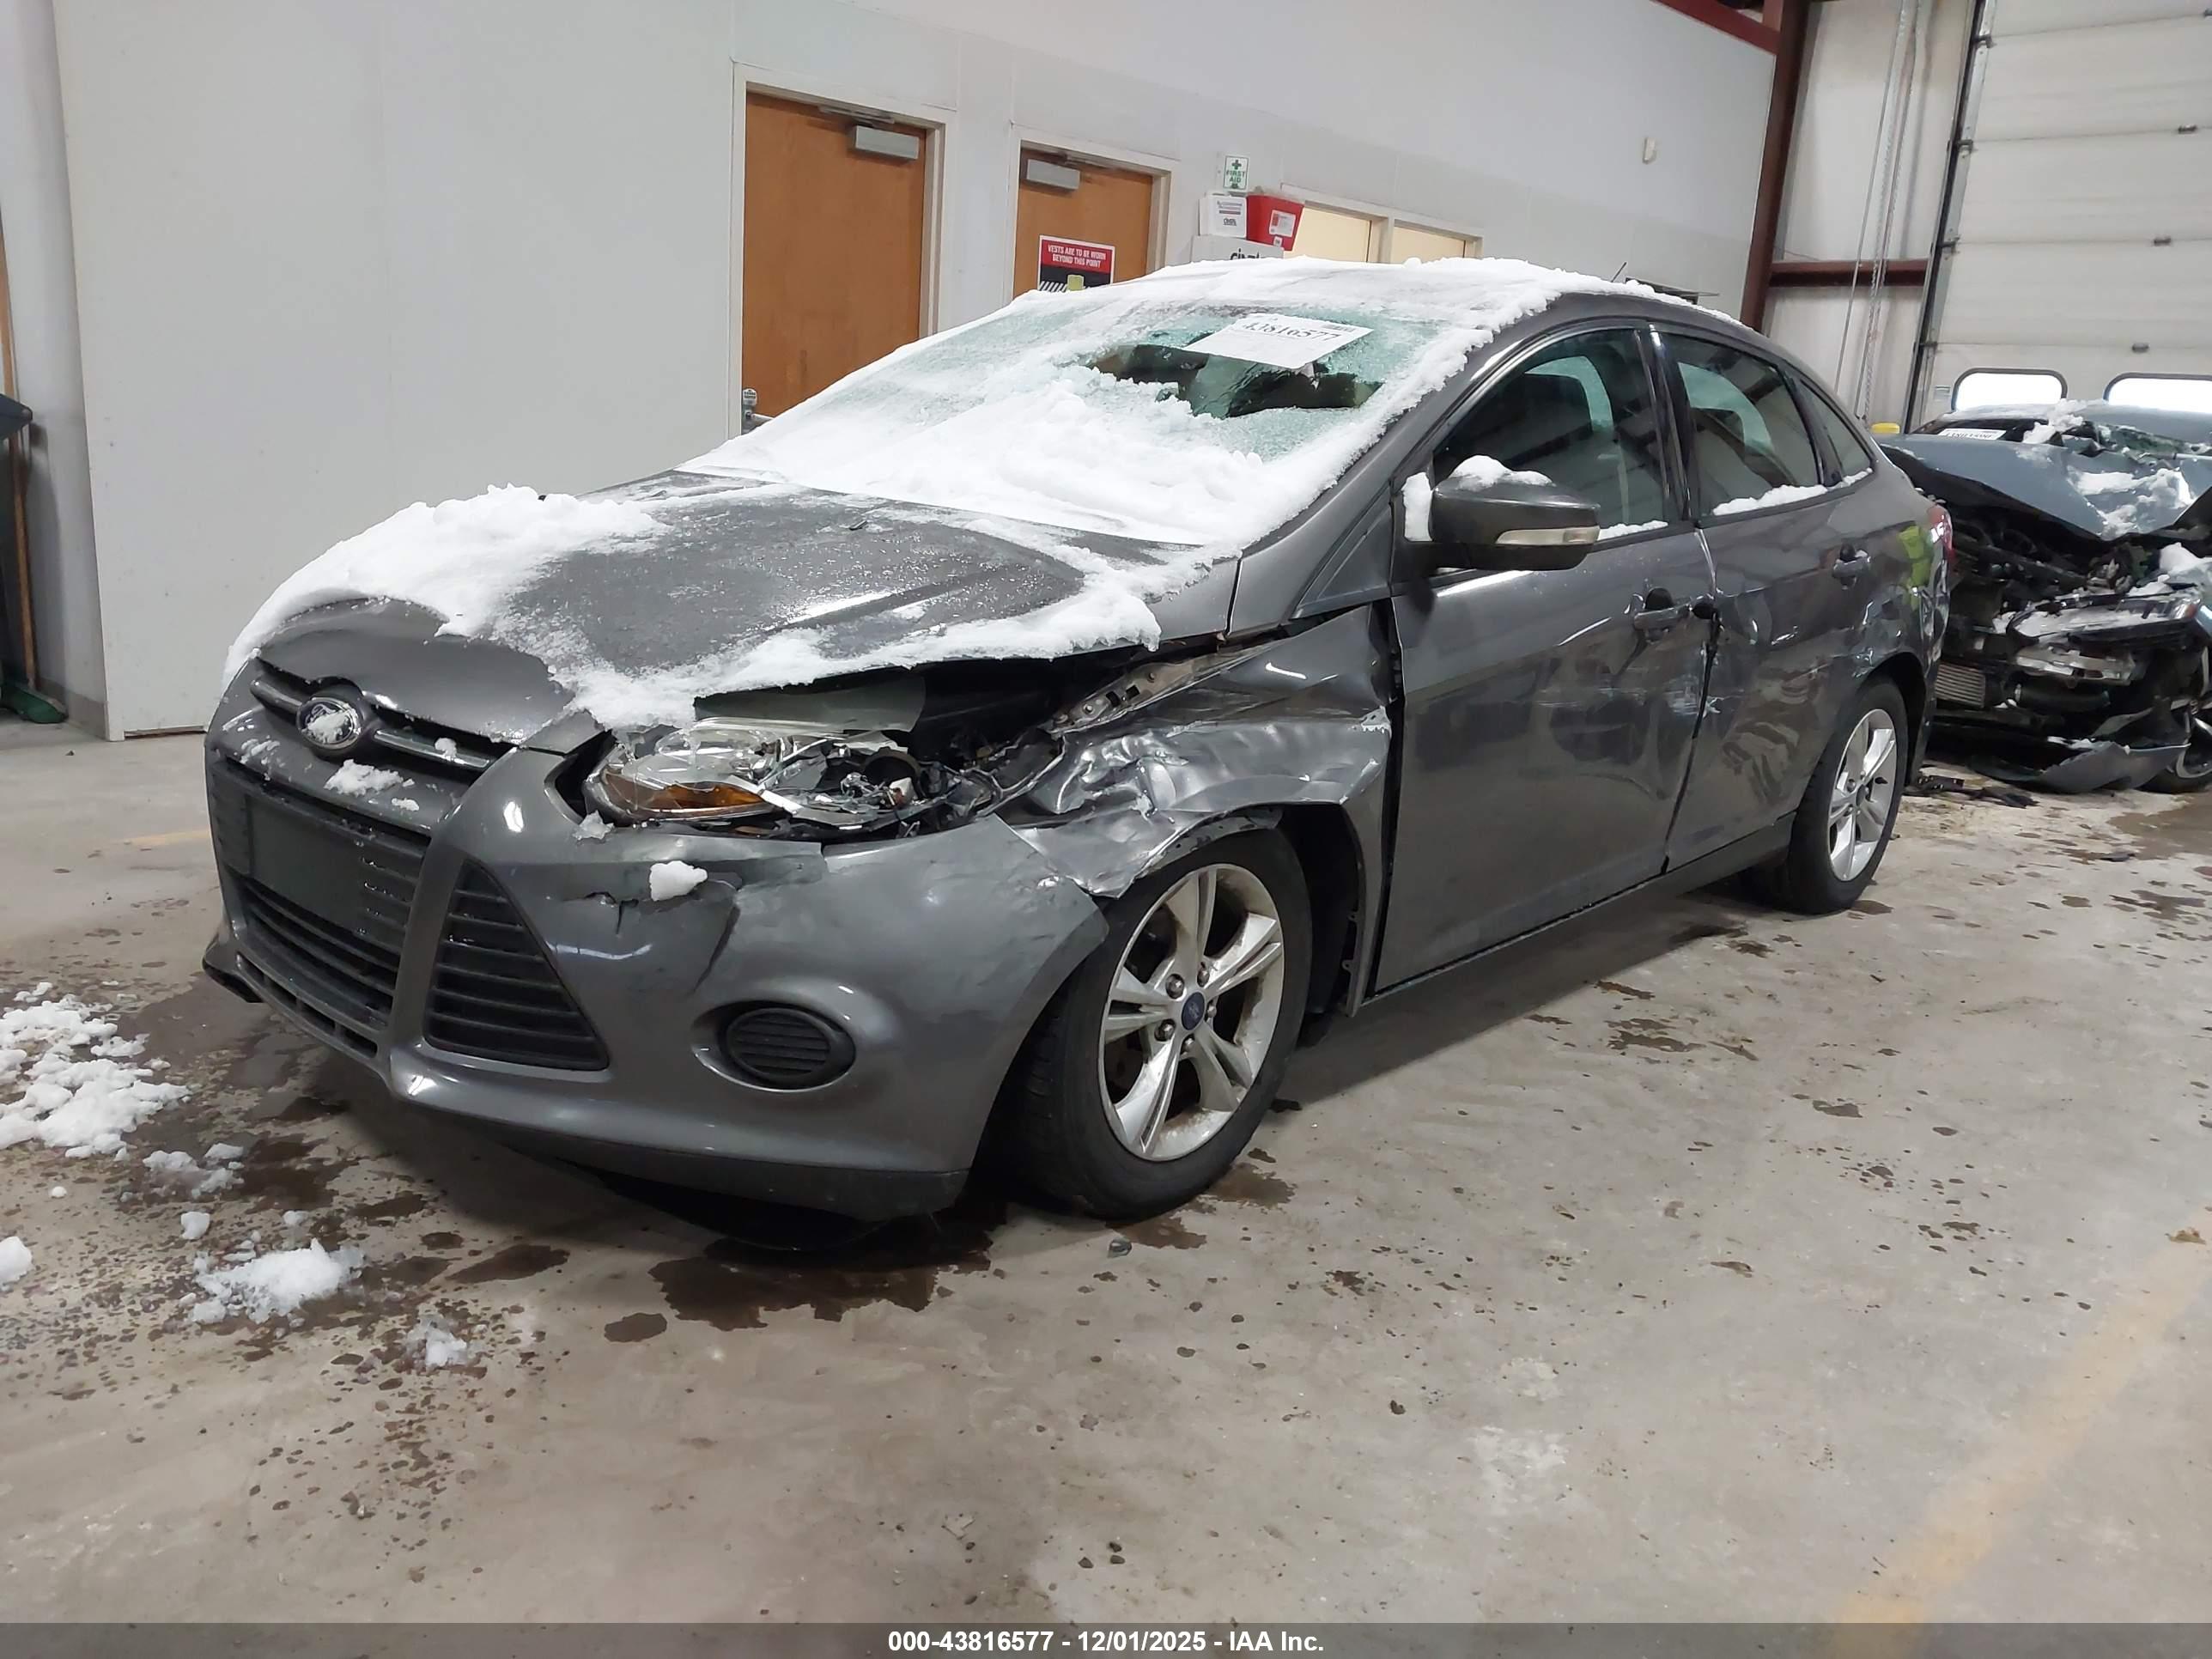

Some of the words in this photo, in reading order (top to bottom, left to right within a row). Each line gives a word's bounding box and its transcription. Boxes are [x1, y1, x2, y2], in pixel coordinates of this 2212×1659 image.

[1048, 245, 1065, 254] VESTS
[1065, 247, 1075, 256] ARE
[1083, 250, 1091, 258] BE
[1052, 253, 1073, 264] BEYOND
[1073, 257, 1085, 266] THIS
[1085, 258, 1101, 268] POINT
